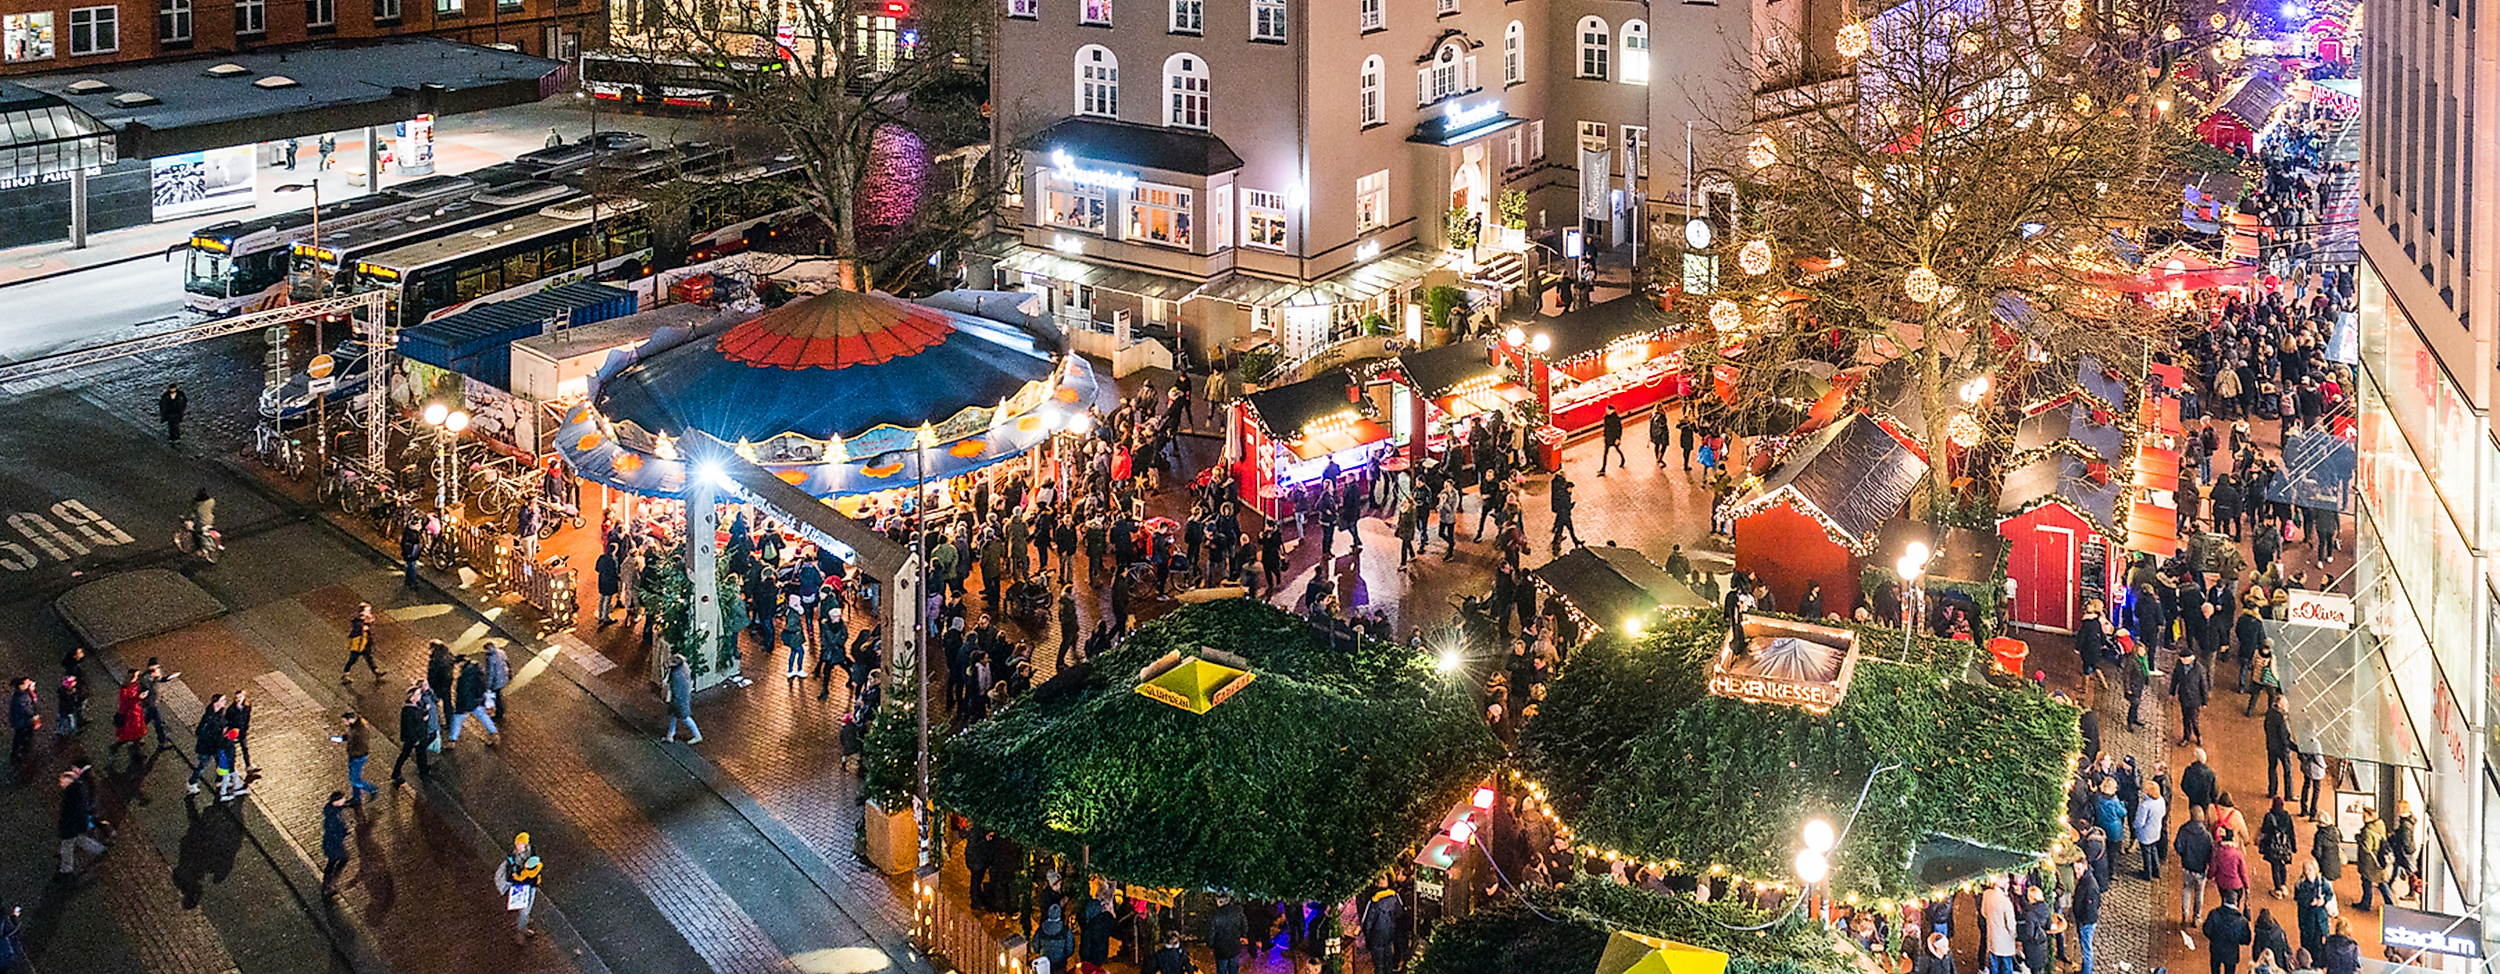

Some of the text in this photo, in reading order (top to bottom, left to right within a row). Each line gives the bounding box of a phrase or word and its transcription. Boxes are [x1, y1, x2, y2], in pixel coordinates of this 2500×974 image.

[2292, 601, 2346, 623] s.Oliver
[1717, 676, 1833, 704] HEXENKESSEL
[2384, 925, 2477, 956] stadium
